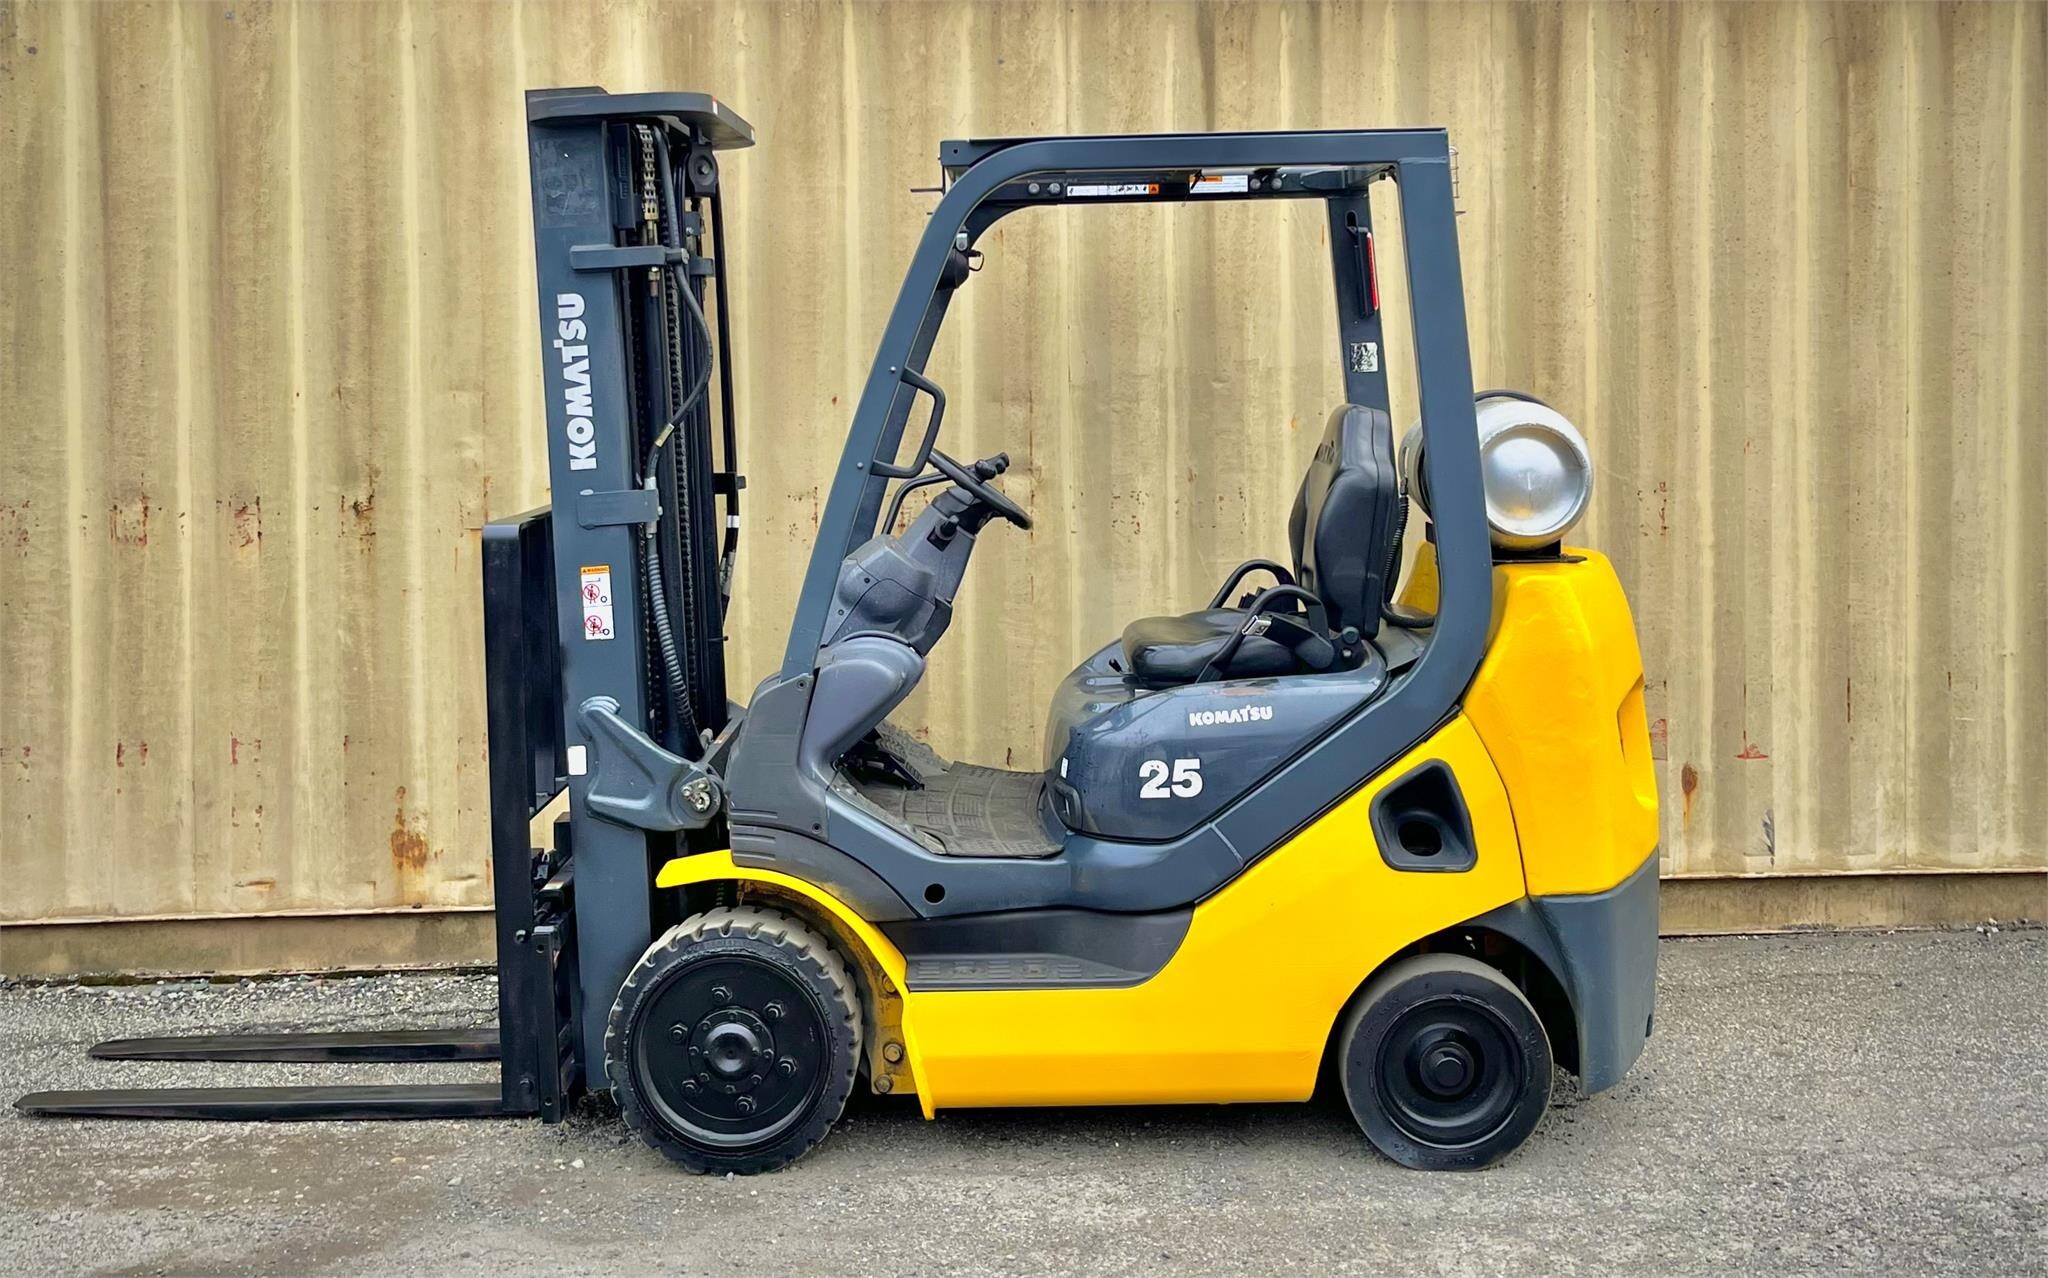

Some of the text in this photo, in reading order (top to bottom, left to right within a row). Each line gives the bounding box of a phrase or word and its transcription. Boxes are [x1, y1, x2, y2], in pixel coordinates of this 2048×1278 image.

[553, 293, 597, 471] KOMATSU
[1189, 705, 1273, 727] KOMATSU
[1139, 758, 1203, 799] 25
